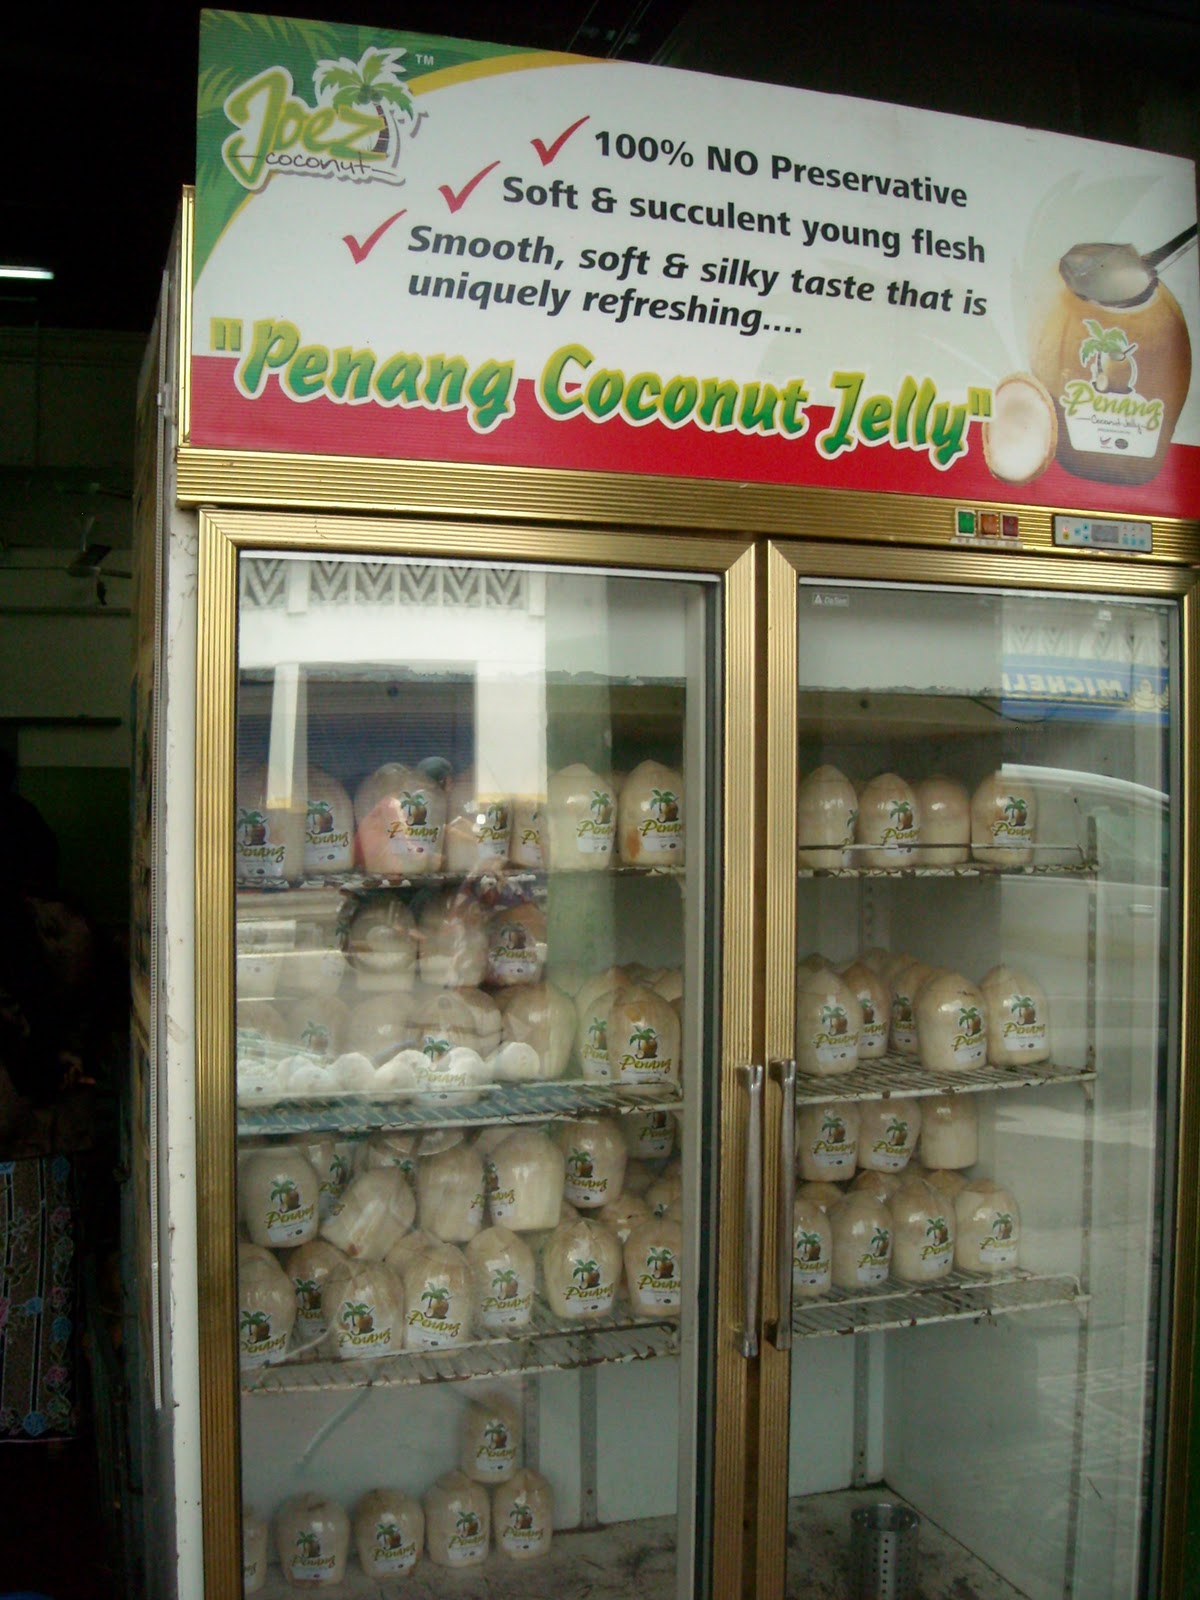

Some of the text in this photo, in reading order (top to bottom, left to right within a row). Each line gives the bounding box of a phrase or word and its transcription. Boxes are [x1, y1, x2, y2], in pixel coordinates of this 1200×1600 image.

[224, 70, 388, 186] Joez
[264, 150, 371, 175] coconut
[594, 130, 968, 207] 100% NO Preservative
[503, 176, 986, 263] Soft & succulent young flesh
[408, 225, 987, 316] Smooth, soft & silky taste that is
[408, 271, 571, 317] uniquely
[536, 343, 810, 438] Coconut
[1062, 382, 1162, 432] Penang
[619, 1054, 672, 1074] Penang
[408, 1309, 461, 1337] Penang
